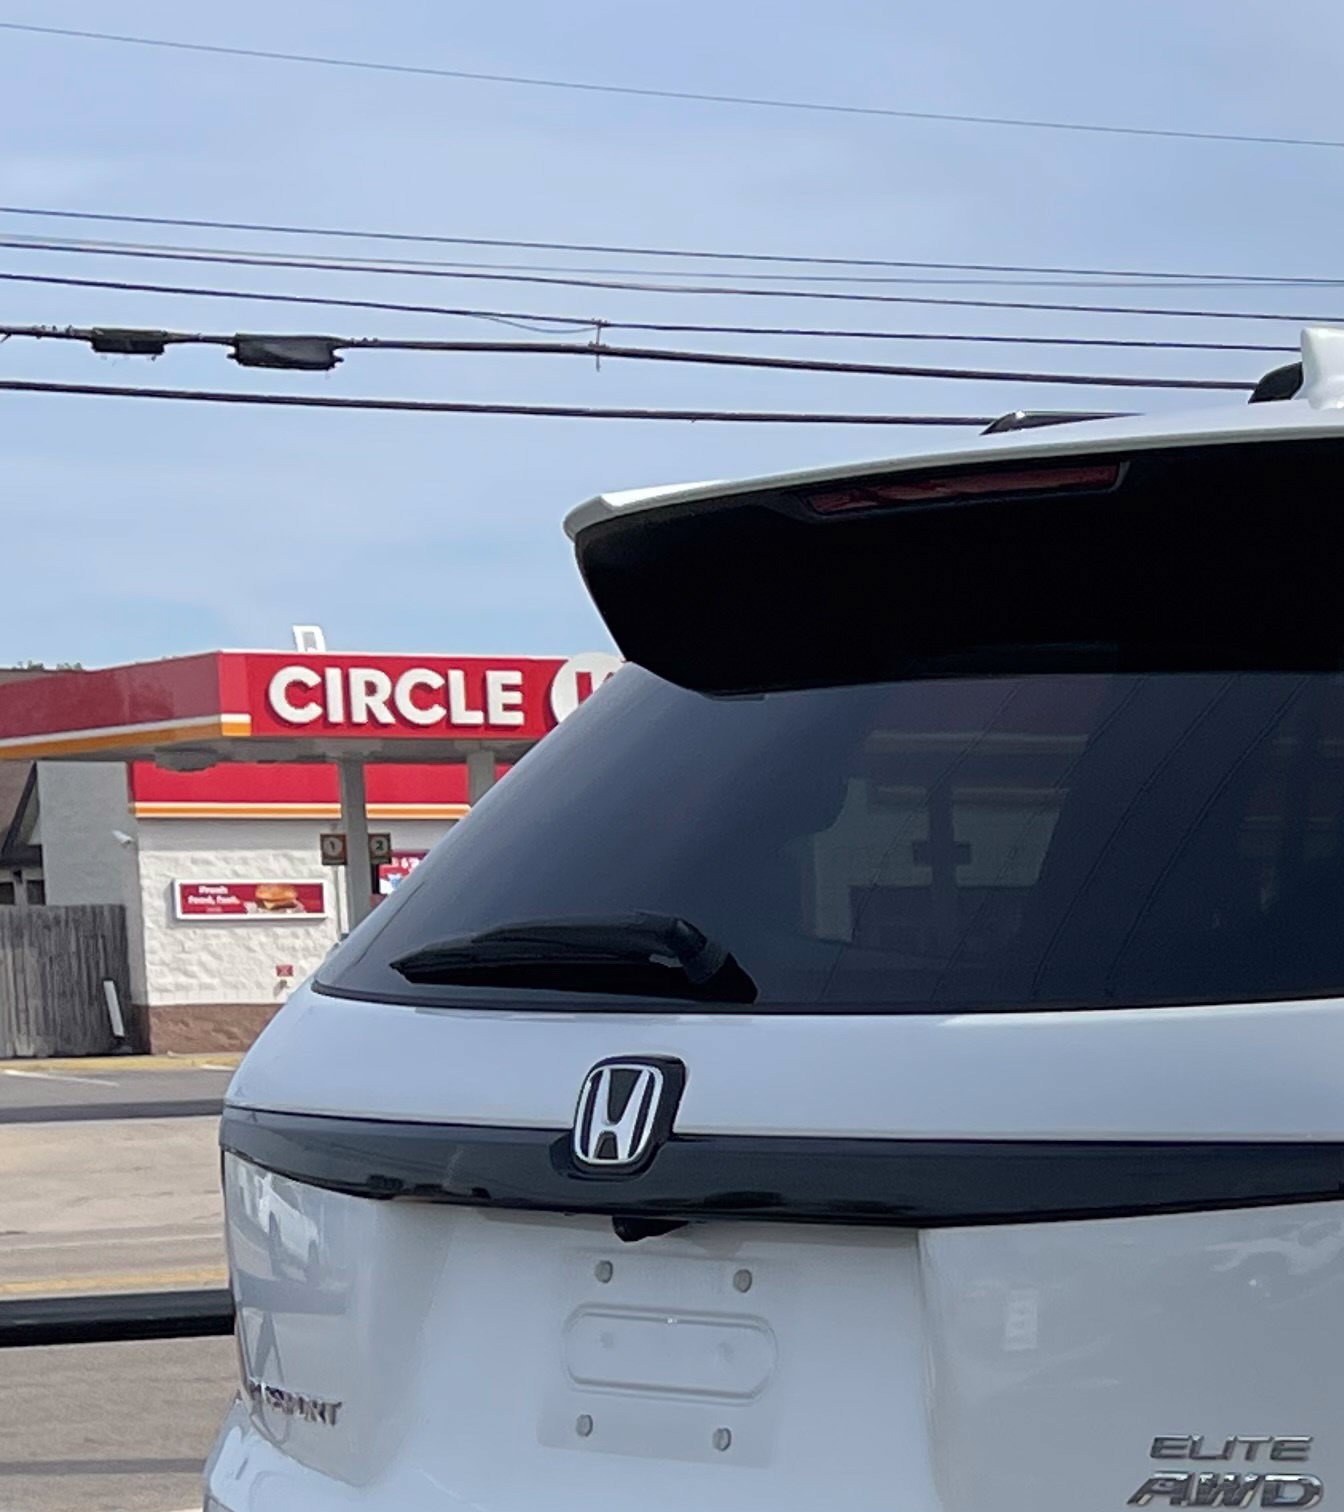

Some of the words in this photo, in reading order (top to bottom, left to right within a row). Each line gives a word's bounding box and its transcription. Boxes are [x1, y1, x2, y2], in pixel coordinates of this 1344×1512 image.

[268, 664, 525, 726] CIRCLE
[1149, 1434, 1314, 1462] ELITE
[1126, 1470, 1325, 1509] AWD
